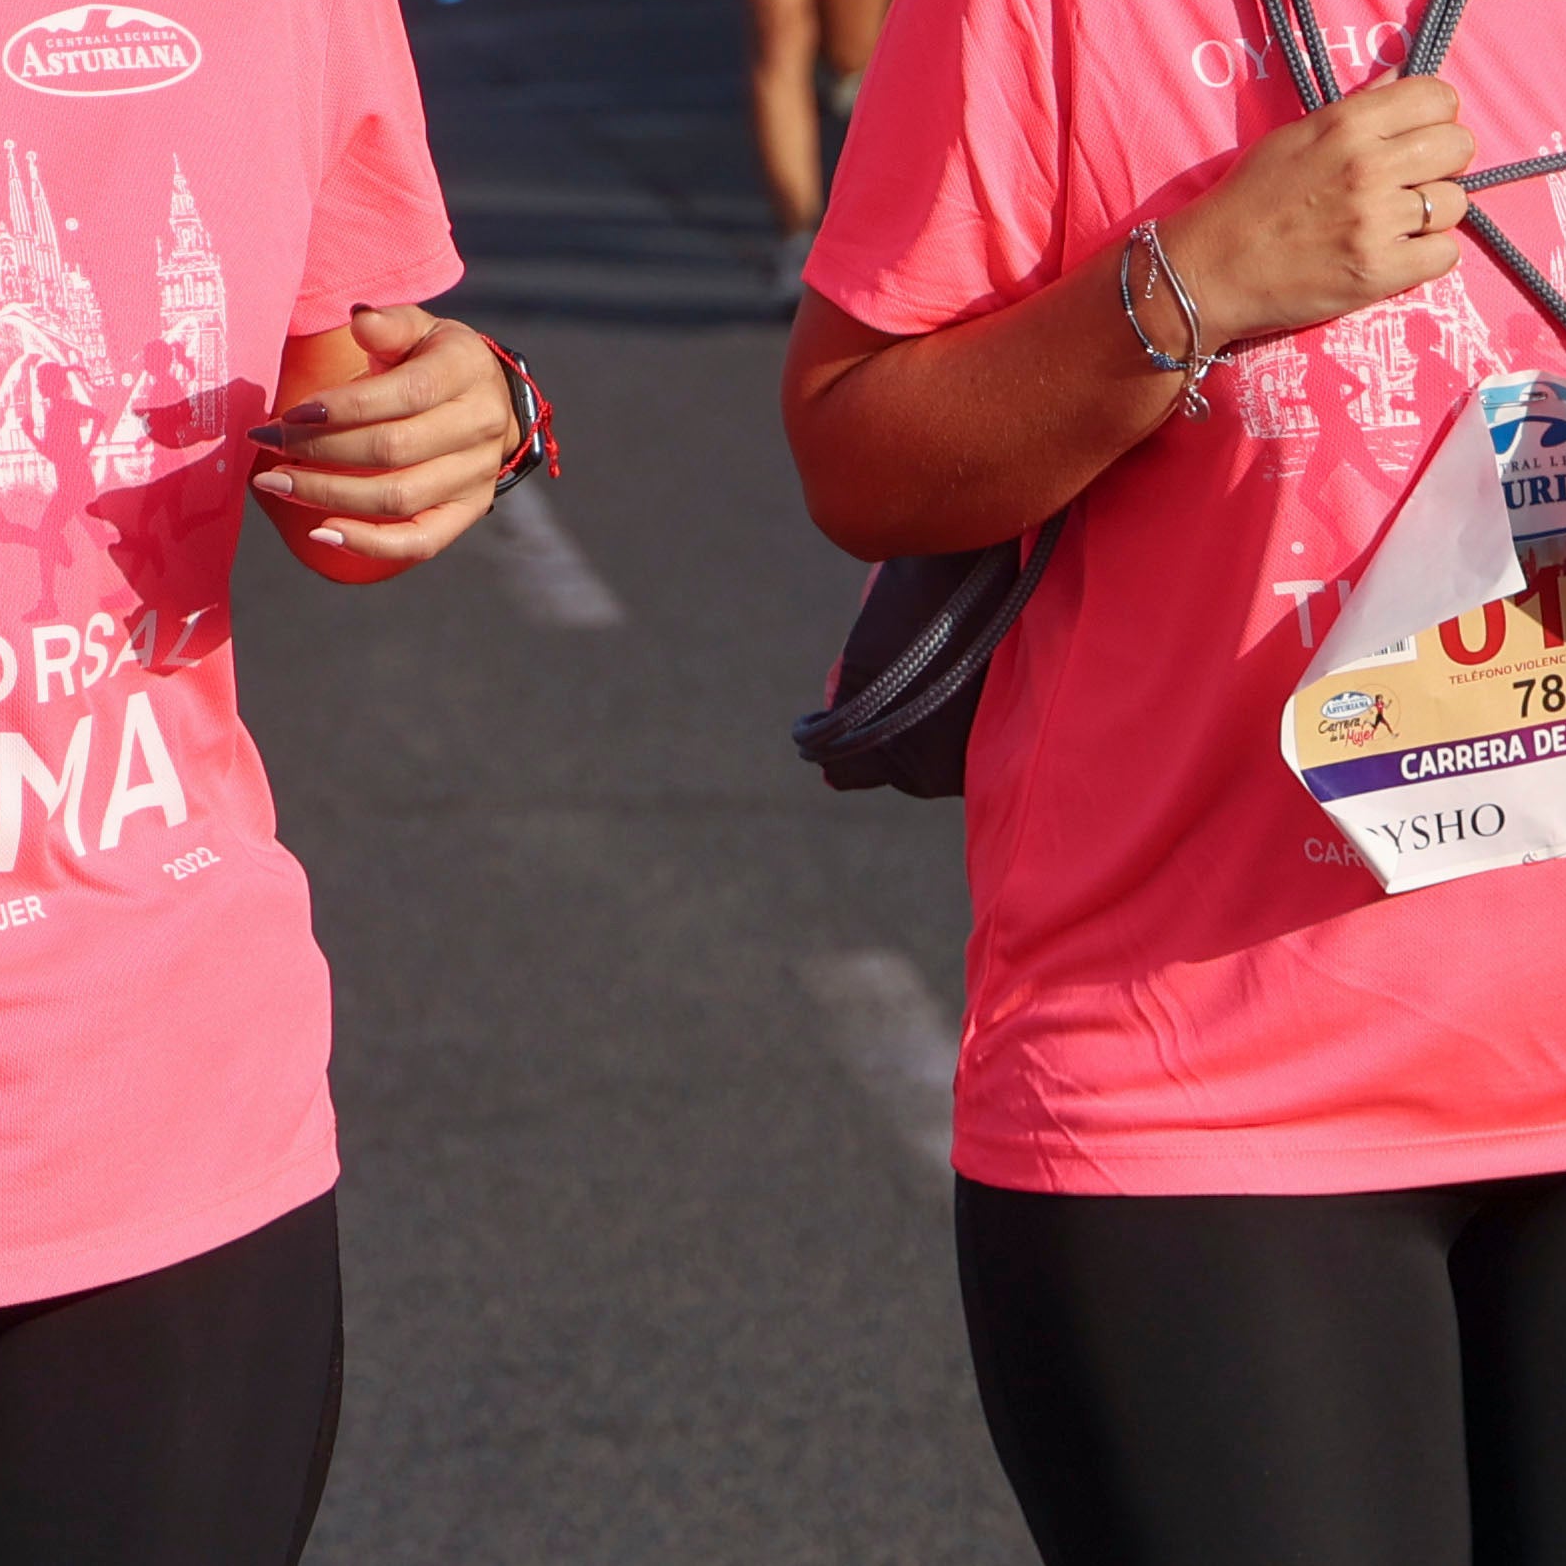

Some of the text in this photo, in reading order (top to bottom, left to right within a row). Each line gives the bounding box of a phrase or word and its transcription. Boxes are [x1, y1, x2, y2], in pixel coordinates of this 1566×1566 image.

[45, 31, 178, 49] CENTRAL LECHERA
[20, 41, 190, 78] ASTURIANA
[1448, 664, 1513, 685] TELÉFONO
[1399, 734, 1528, 781] CARRERA
[1366, 802, 1507, 855] YSHO
[161, 846, 222, 881] 2022
